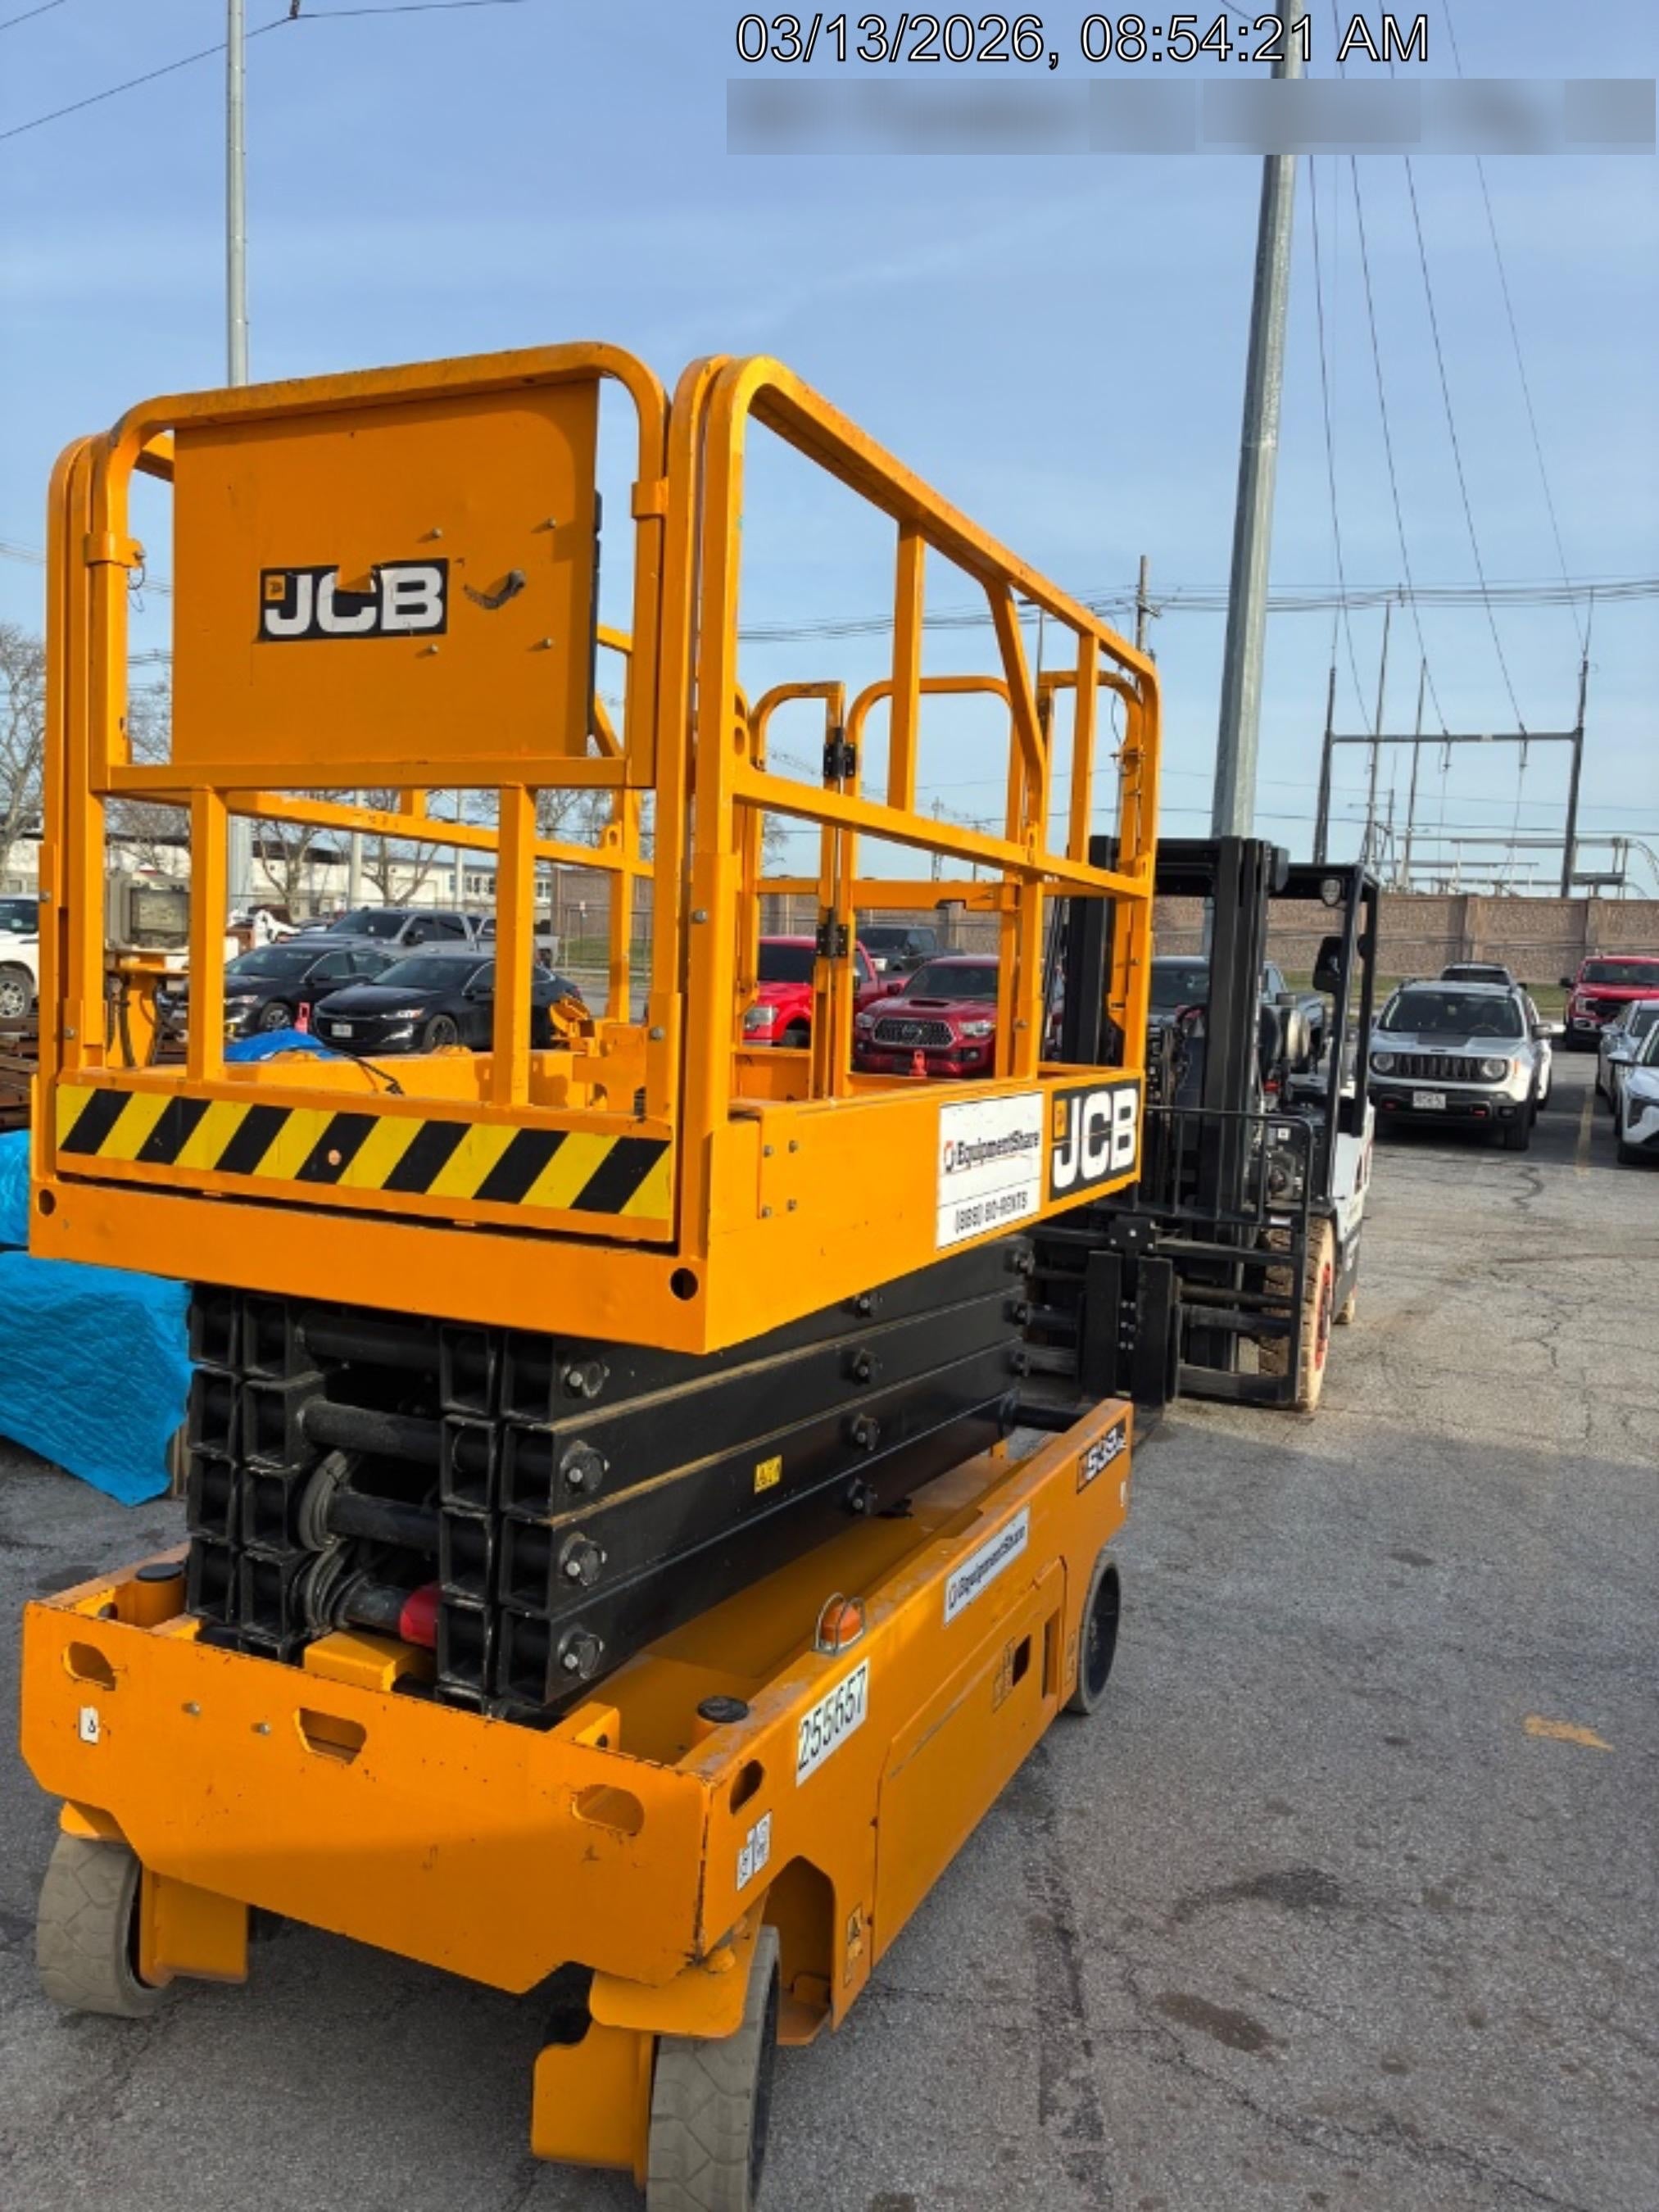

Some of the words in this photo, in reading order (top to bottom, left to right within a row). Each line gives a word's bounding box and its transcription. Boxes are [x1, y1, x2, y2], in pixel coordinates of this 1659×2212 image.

[264, 566, 444, 636] JCB
[957, 1130, 1040, 1170] EquipmentShare
[1053, 1087, 1140, 1189] JCB
[798, 1665, 866, 1771] 255657
